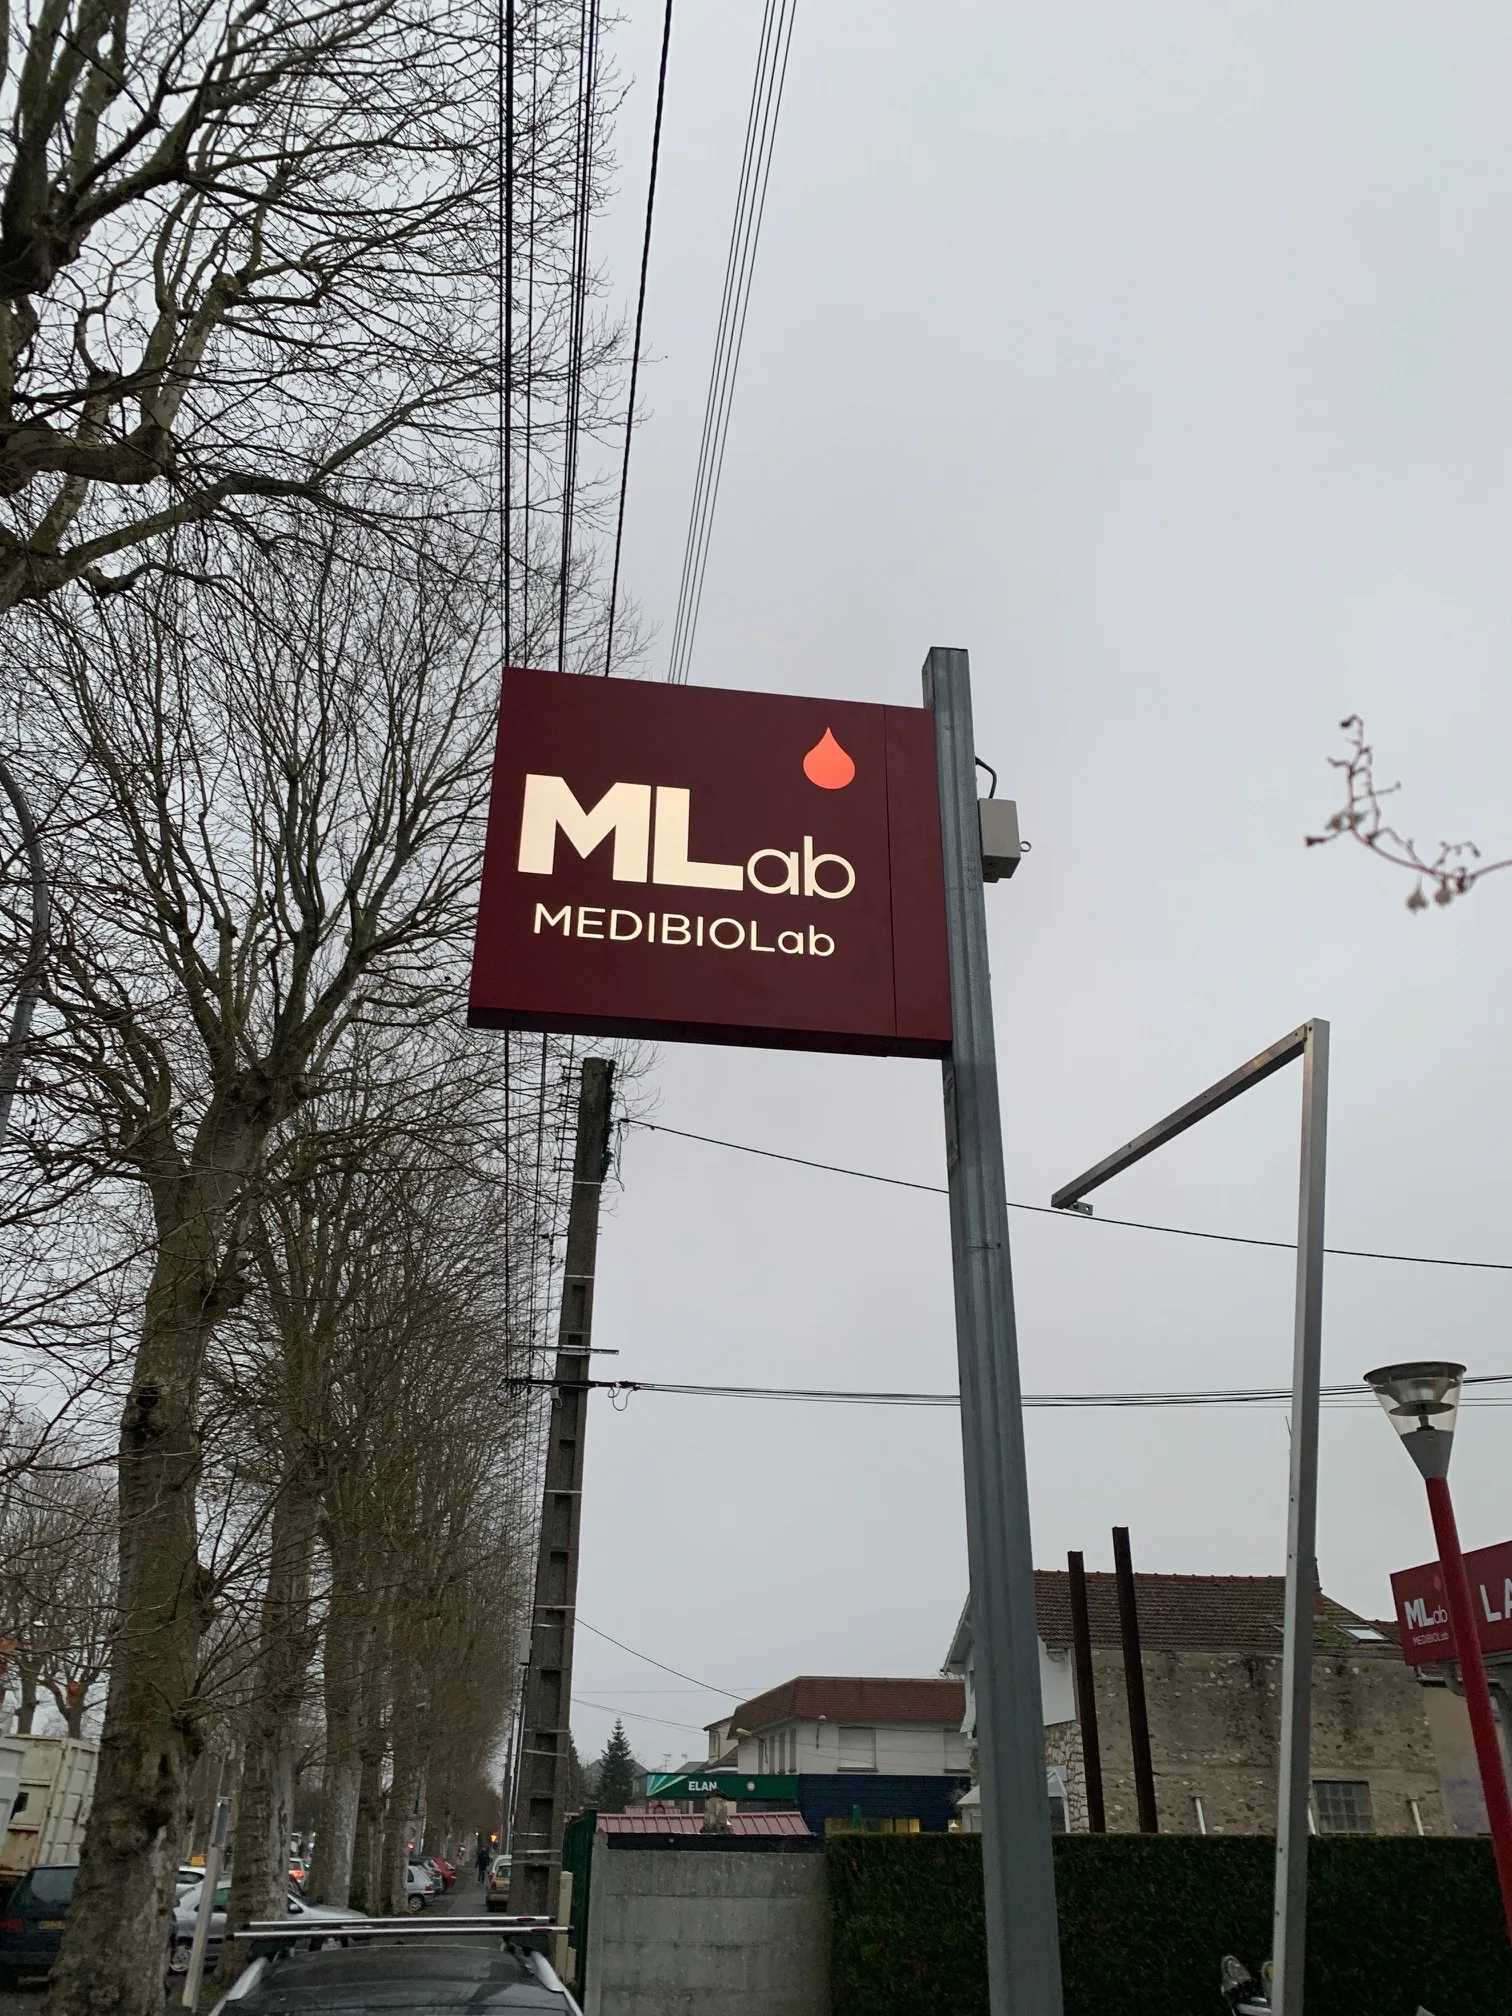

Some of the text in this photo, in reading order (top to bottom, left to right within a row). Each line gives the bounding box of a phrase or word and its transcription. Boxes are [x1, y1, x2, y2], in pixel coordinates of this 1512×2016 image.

[517, 773, 856, 899] MLab
[533, 902, 836, 957] MEDIBIOLab
[1404, 1598, 1448, 1630] MLab
[688, 1781, 718, 1792] ELAN
